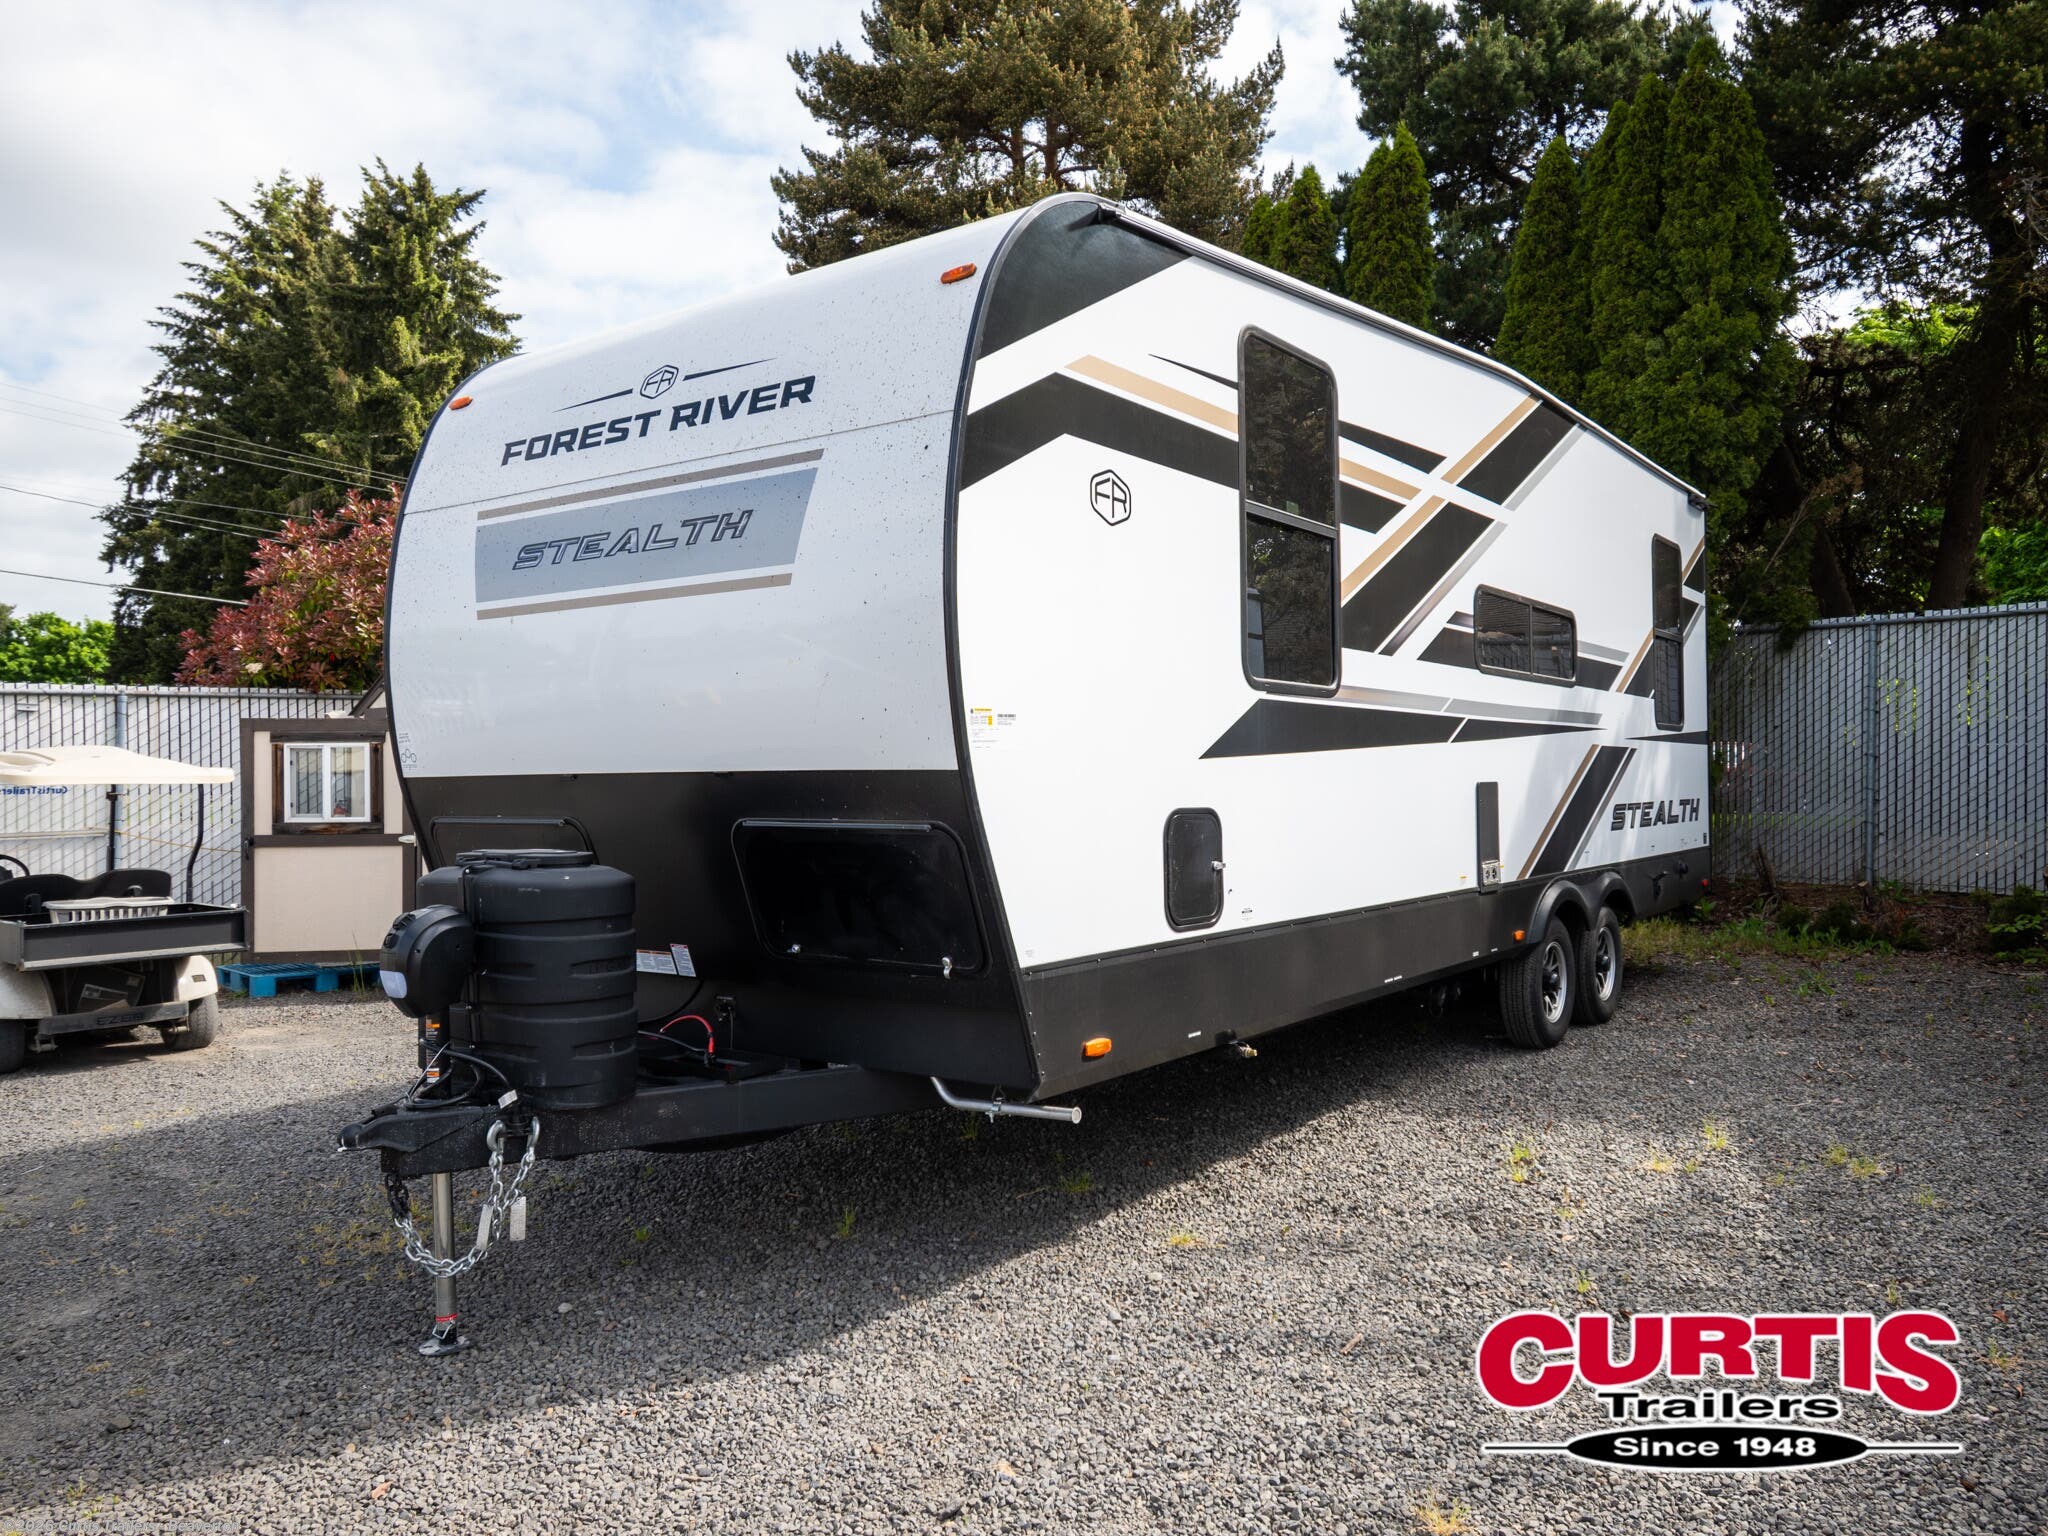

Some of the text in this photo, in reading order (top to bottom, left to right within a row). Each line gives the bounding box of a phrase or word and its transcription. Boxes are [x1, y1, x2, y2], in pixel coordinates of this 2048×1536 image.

[501, 375, 816, 467] FOREST RIVER
[512, 509, 754, 570] STEALTH
[1610, 798, 1700, 832] STEALTH
